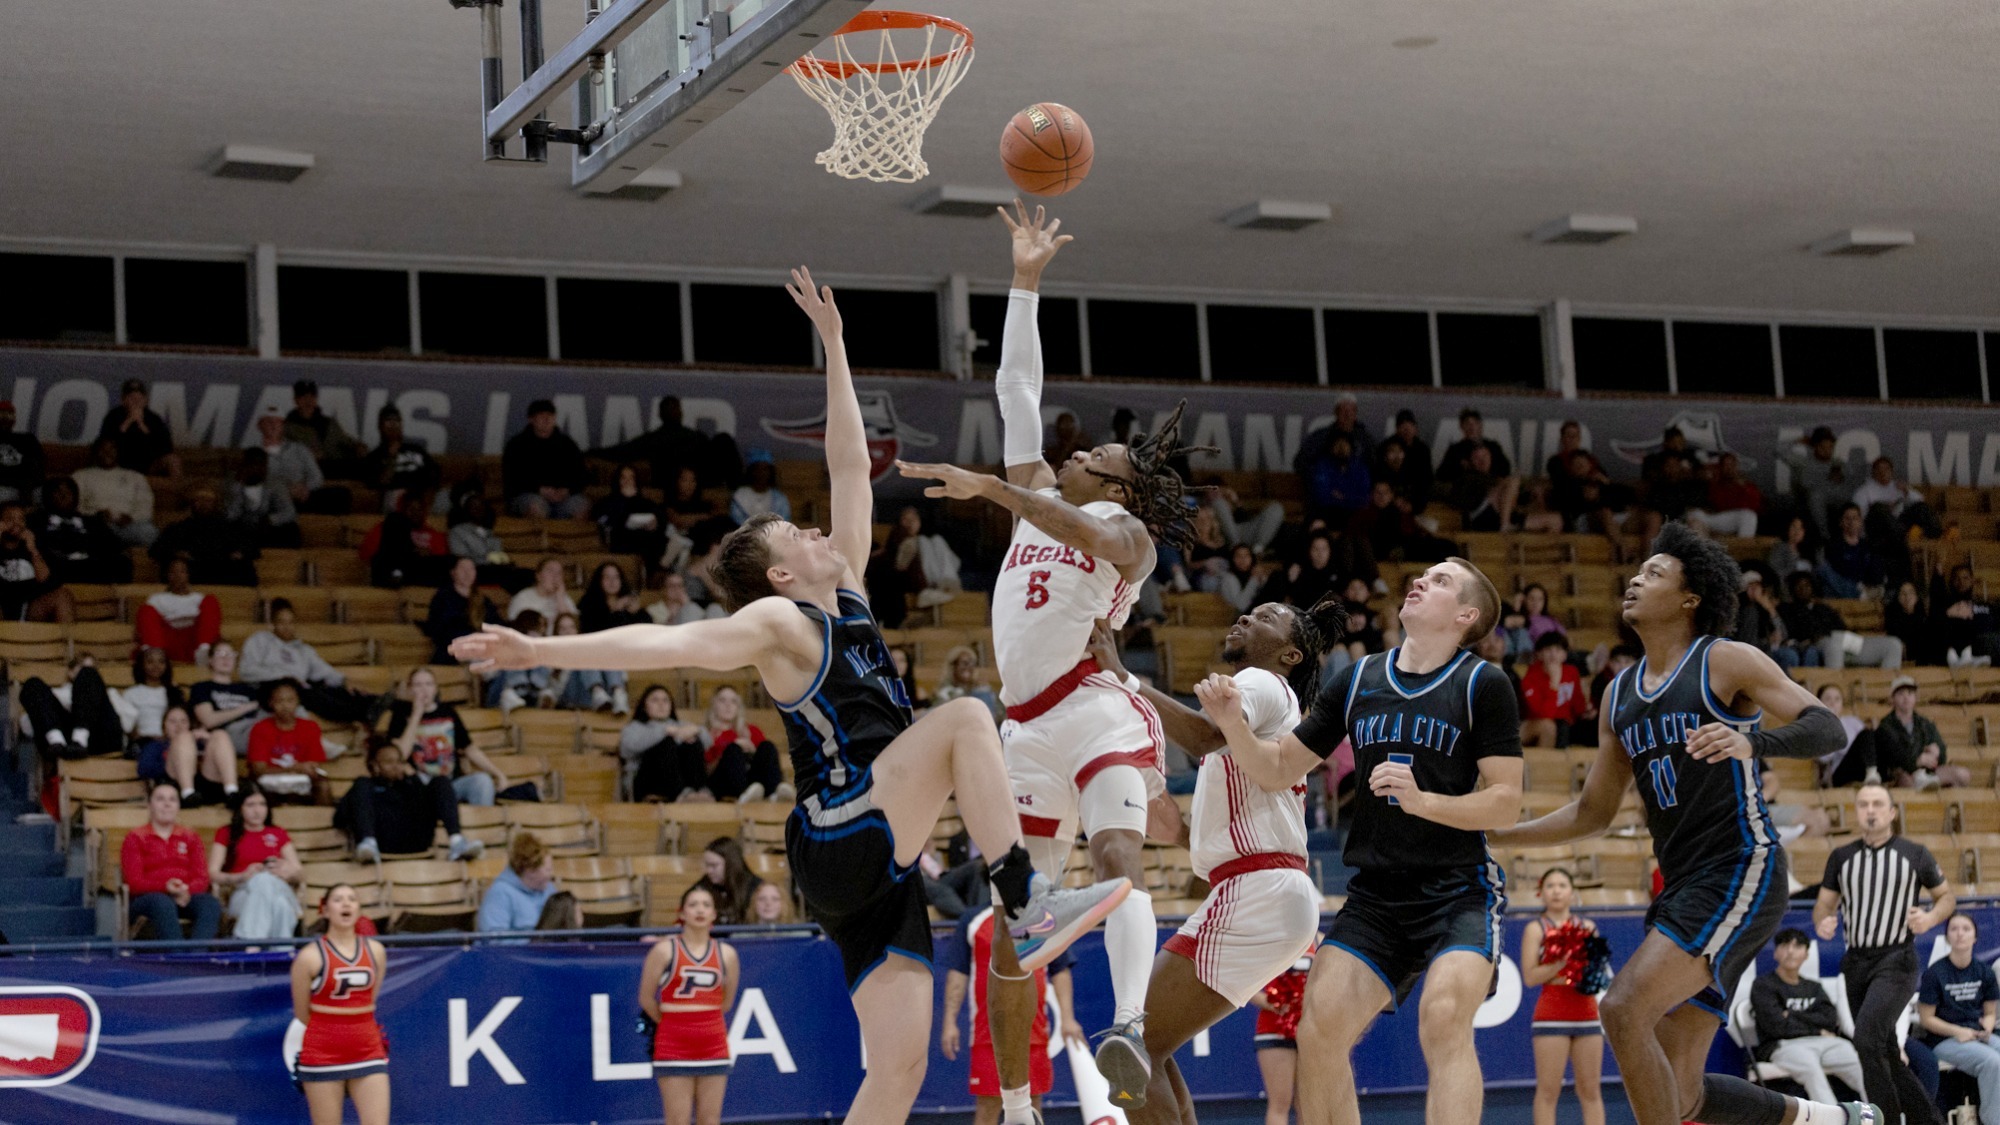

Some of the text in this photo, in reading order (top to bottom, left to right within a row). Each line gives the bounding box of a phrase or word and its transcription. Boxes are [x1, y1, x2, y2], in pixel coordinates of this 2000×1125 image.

[1005, 543, 1096, 574] AGGIES
[1025, 570, 1051, 611] 5
[1355, 711, 1461, 757] OKLA CITY
[1621, 718, 1657, 759] KLA
[1649, 755, 1678, 811] 11
[330, 966, 375, 999] P
[673, 965, 721, 998] P
